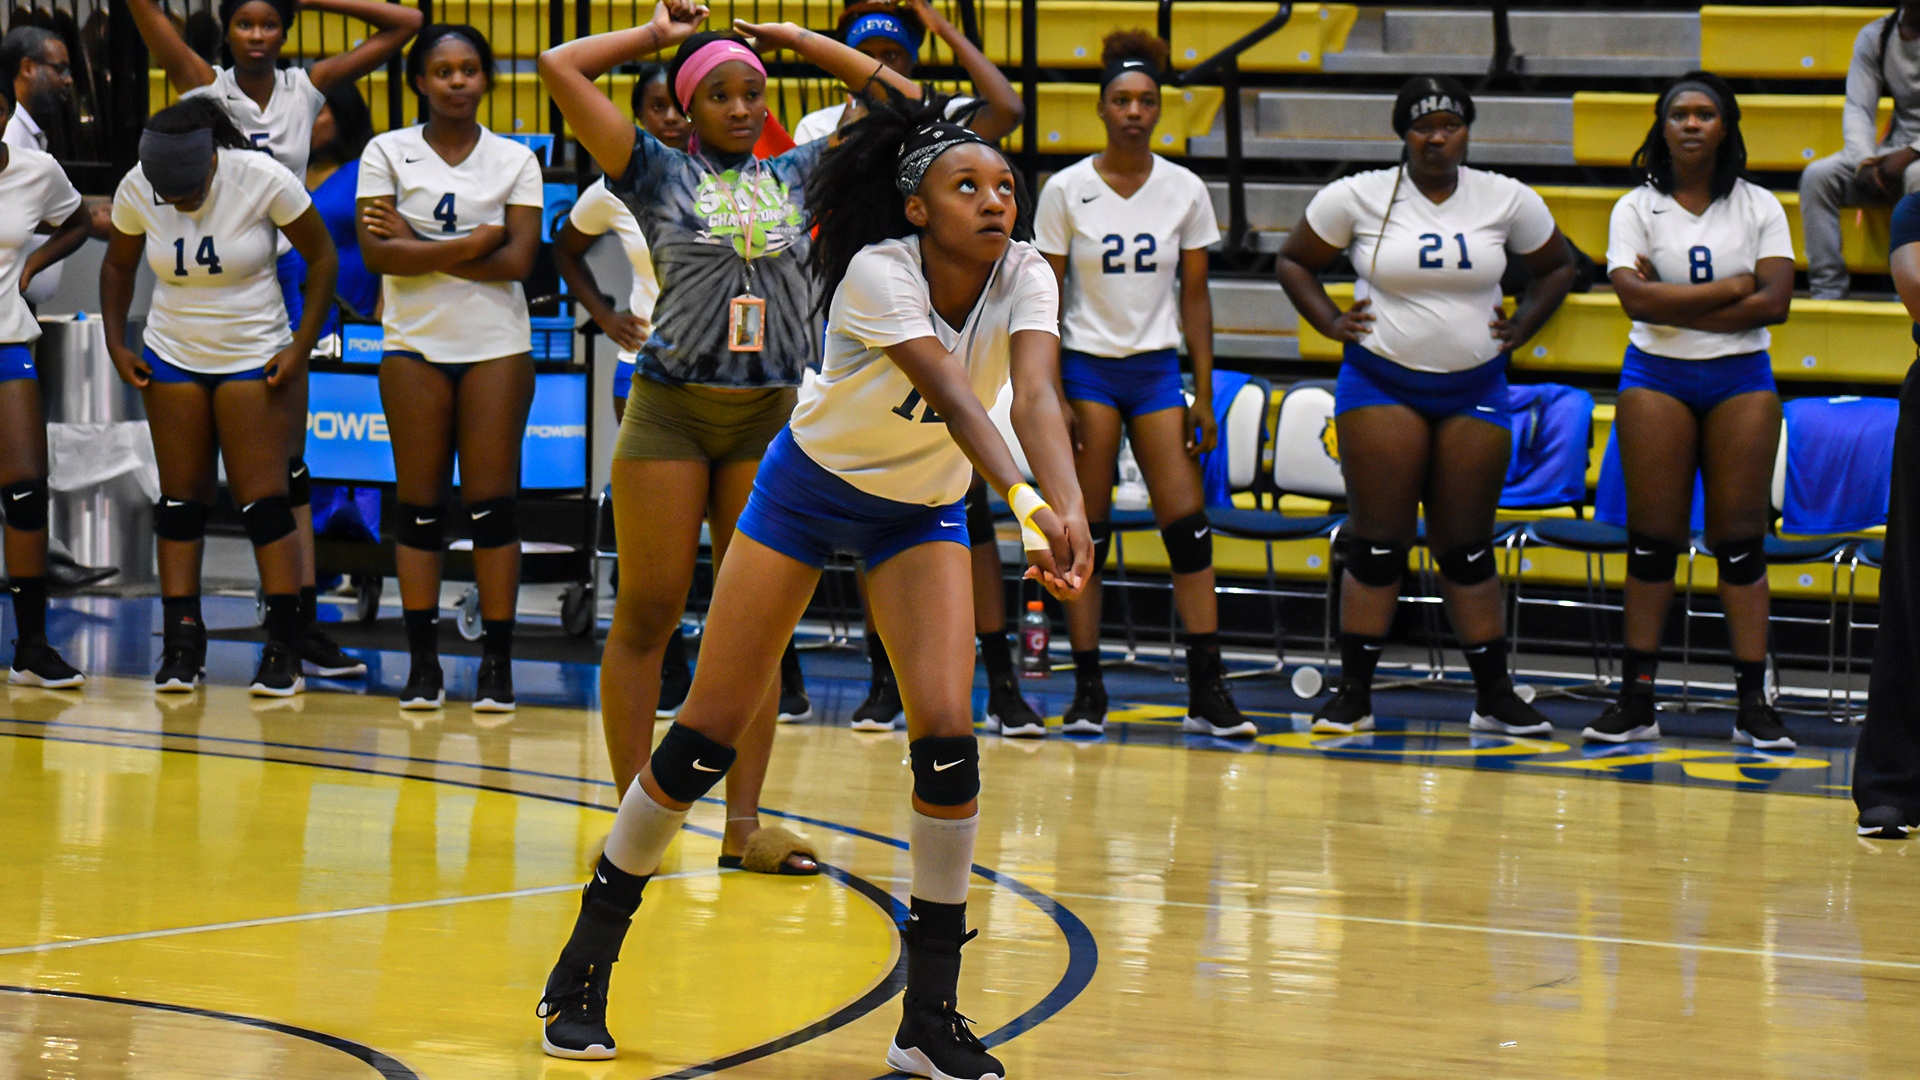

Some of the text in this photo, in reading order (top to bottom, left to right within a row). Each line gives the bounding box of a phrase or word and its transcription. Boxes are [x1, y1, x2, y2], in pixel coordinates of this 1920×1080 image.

[433, 192, 457, 233] 4
[173, 235, 223, 277] 14
[1102, 233, 1157, 274] 22
[1419, 233, 1472, 269] 21
[1689, 245, 1714, 285] 8
